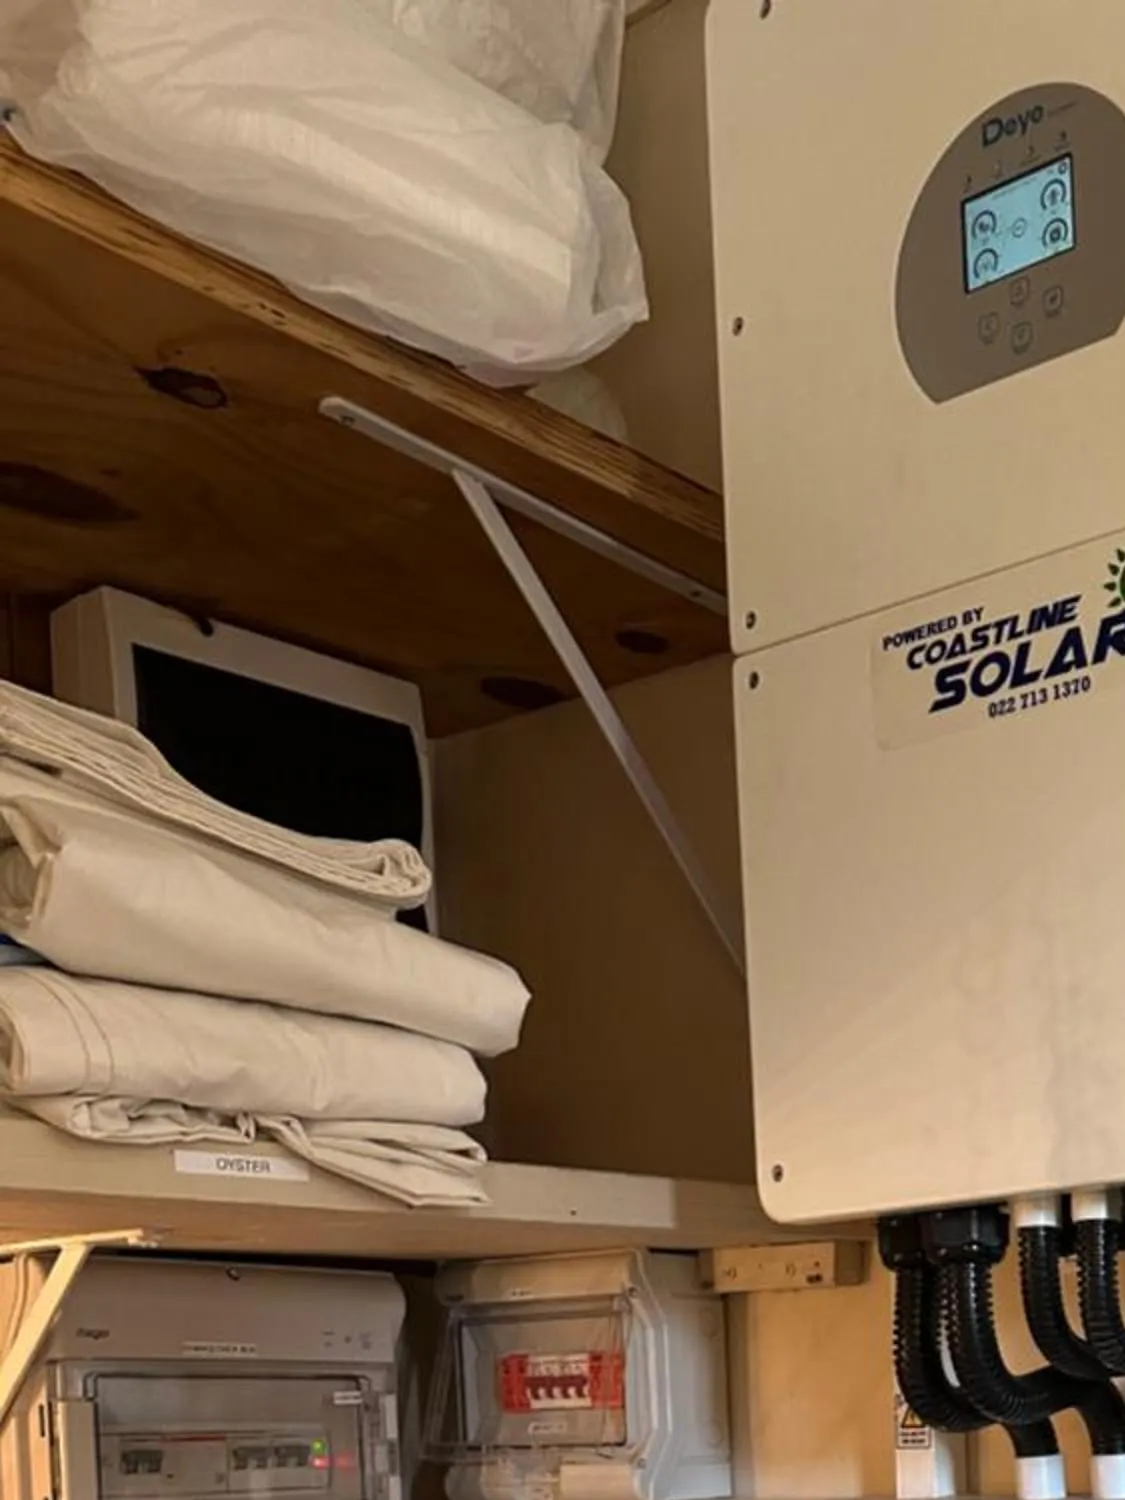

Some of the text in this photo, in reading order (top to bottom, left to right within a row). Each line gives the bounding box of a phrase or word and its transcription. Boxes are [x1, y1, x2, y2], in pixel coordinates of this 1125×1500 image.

[981, 105, 1044, 148] Deye
[882, 606, 984, 651] POWERED BY
[906, 594, 1082, 671] COASTLINE
[988, 697, 1016, 718] 022
[1020, 688, 1048, 710] 713
[215, 1157, 271, 1174] OYSTER
